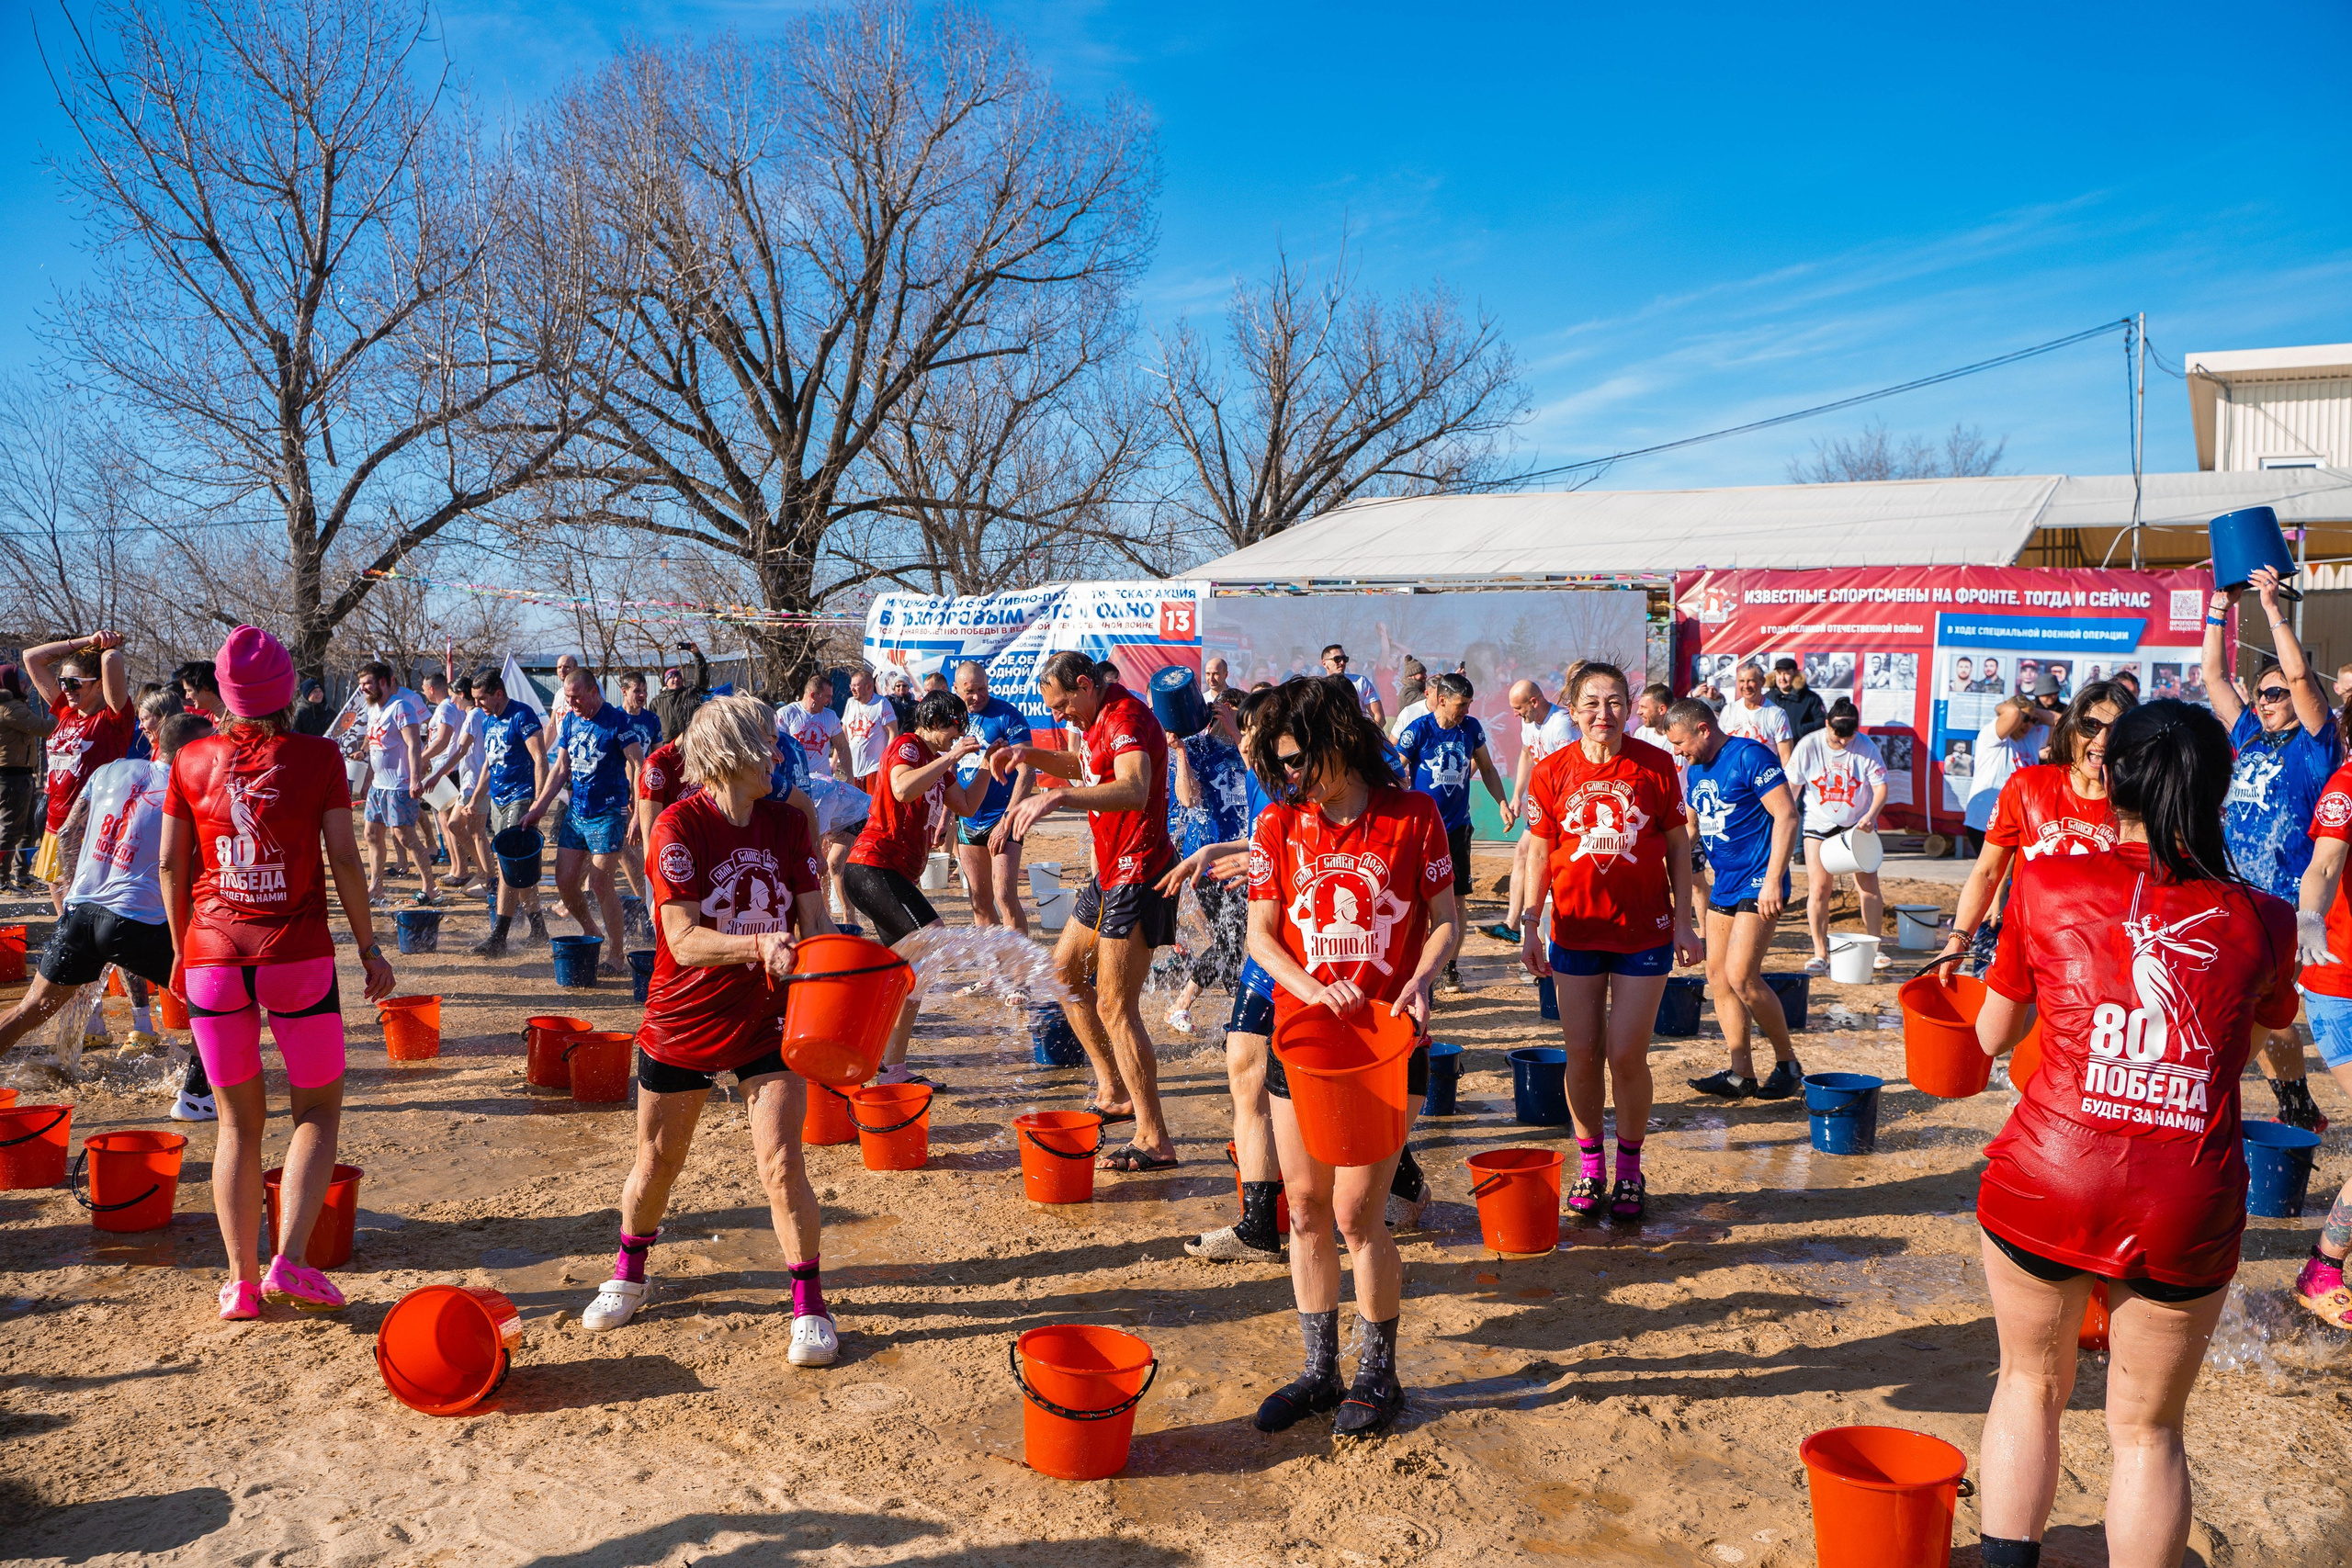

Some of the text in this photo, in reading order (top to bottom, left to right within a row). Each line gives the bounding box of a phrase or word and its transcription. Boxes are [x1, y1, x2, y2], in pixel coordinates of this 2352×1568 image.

[1156, 589, 1195, 599] АКЦИЯ
[1744, 587, 2151, 608] ИЗВЕСТНЫЕ СПОРТСМЕНЫ НА ФРОНТЕ. ТОГДА И СЕЙЧАС
[960, 626, 999, 636] ПОБЕДЫ
[1001, 626, 1008, 635] В
[1125, 620, 1154, 629] ВОЙНЕ
[1165, 610, 1190, 632] 13
[1760, 625, 1766, 634] В
[1767, 625, 1790, 635] ГОДЫ
[1827, 623, 1892, 634] ОТЕЧЕСТВЕННОЙ
[1893, 623, 1923, 634] ВОЙНЫ
[1947, 626, 2129, 641] В ХОДЕ СПЕЦИАЛЬНОЙ ВОЕННОЙ ОПЕРАЦИИ
[95, 838, 135, 863] ПОБЕДА
[215, 835, 255, 867] 80
[1436, 854, 1451, 868] ПУТ
[220, 870, 287, 892] ПОБЕДА
[1295, 853, 1385, 888] СИЛА СЛАВА ДОЛГ
[220, 889, 287, 903] БУДЕТ ЗА НАМИ!
[1311, 932, 1379, 956] ЯРОПОЛК
[2089, 1002, 2167, 1062] 80
[2085, 1062, 2208, 1112] ПОБЕДА
[2081, 1098, 2205, 1134] БУДЕТ ЗА НАМИ!
